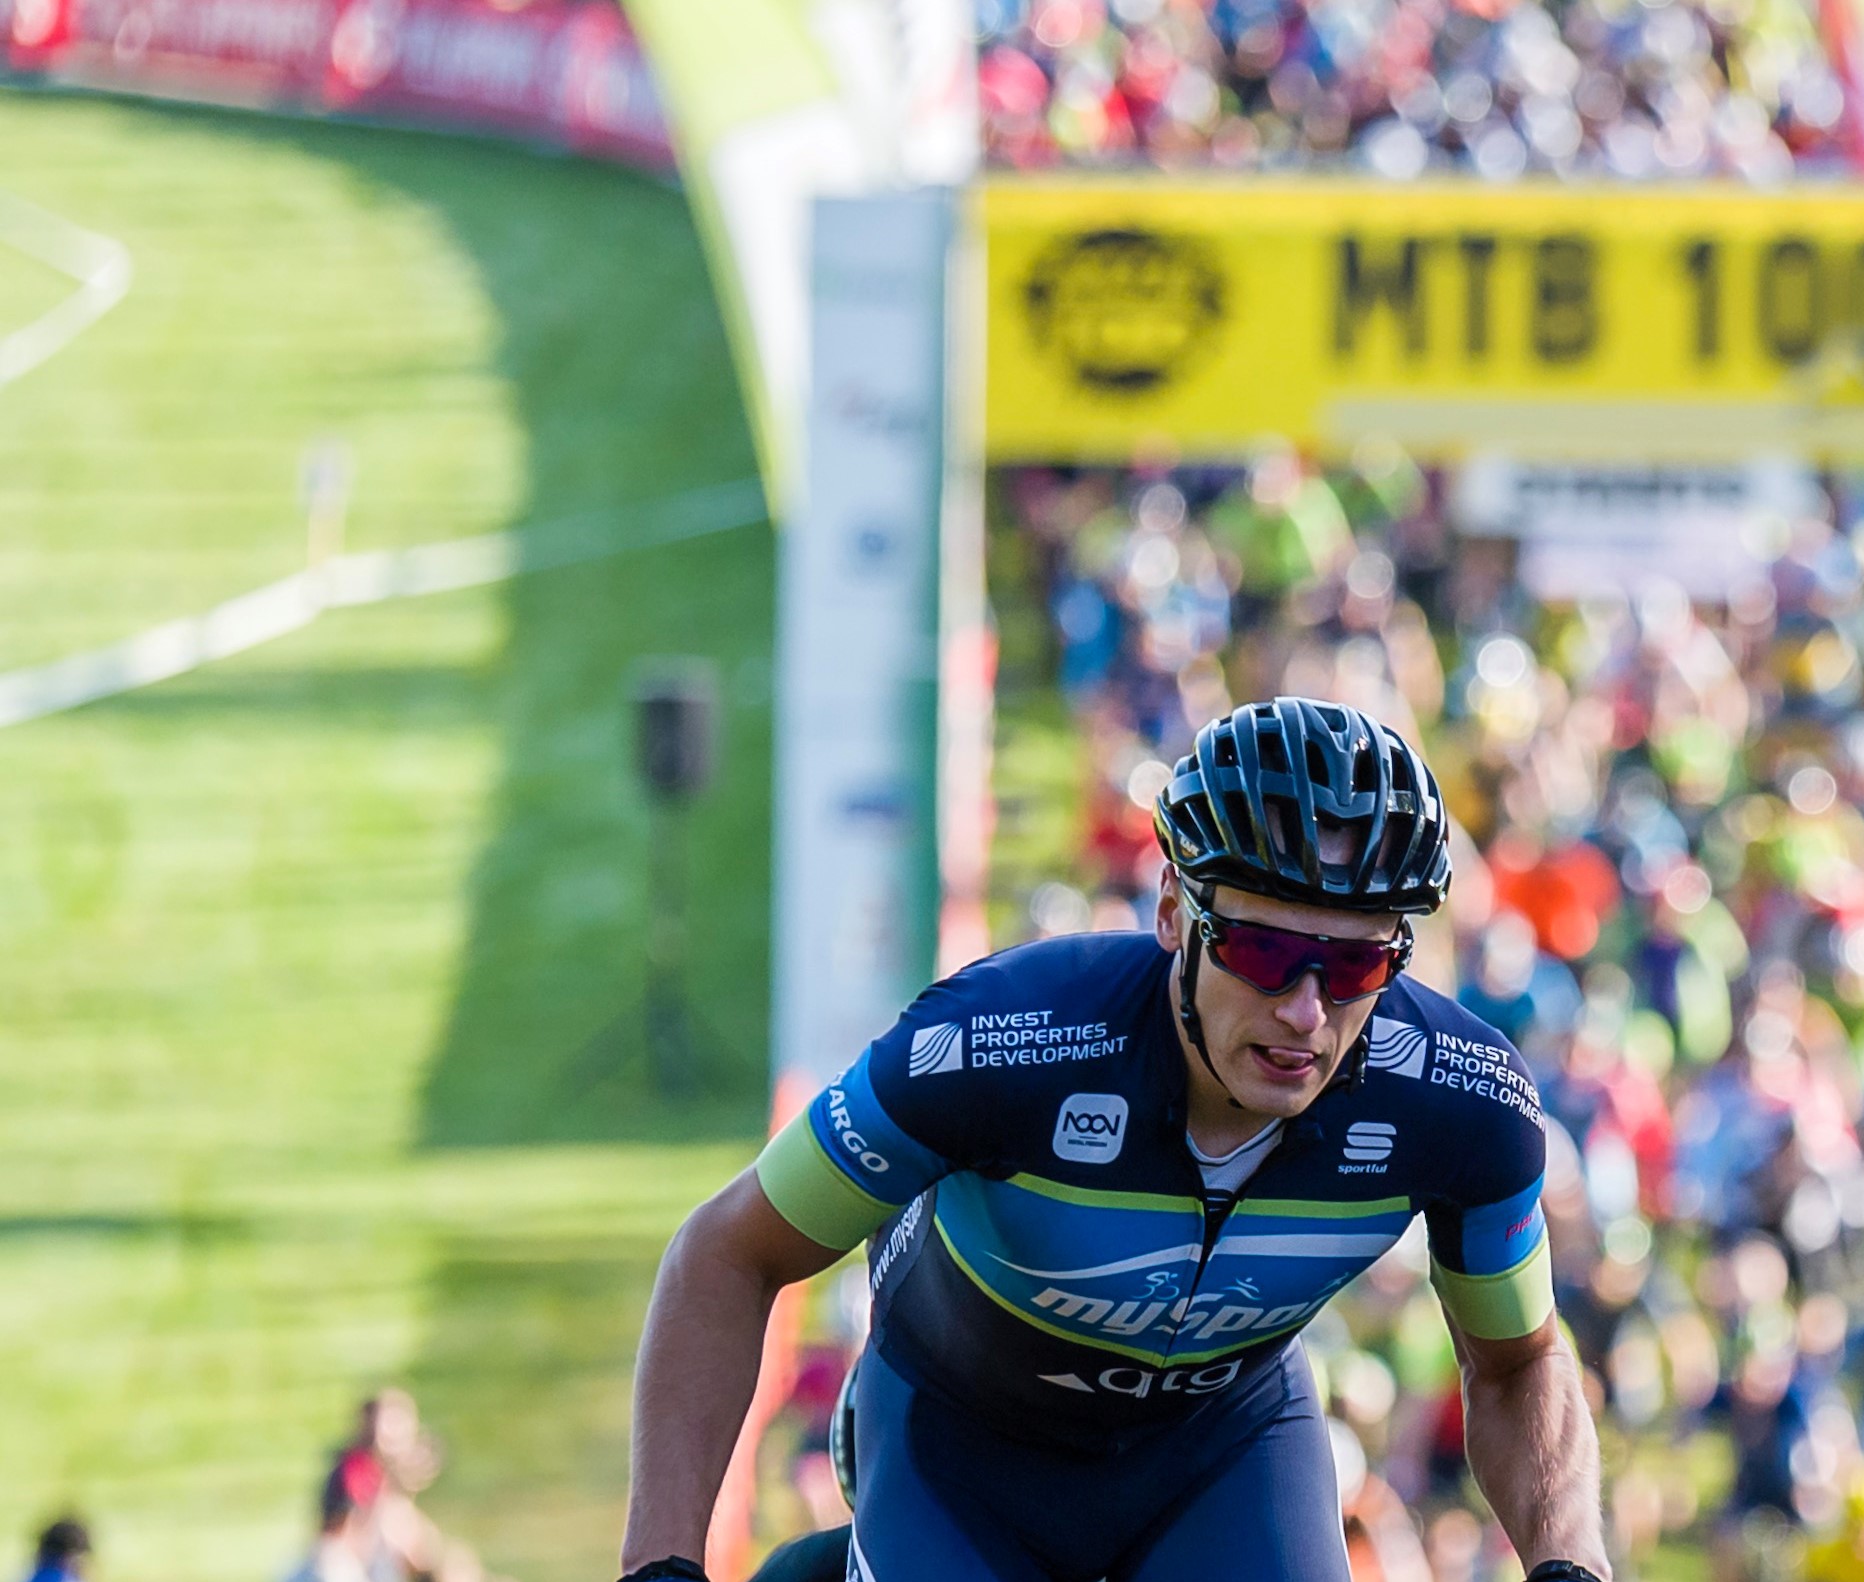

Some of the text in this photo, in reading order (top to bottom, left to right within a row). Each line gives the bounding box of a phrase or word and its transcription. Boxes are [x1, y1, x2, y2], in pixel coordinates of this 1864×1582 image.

[1330, 233, 1606, 368] MTB
[971, 1011, 1053, 1031] INVEST
[971, 1022, 1108, 1050] PROPERTIES
[971, 1035, 1129, 1069] DEVELOPMENT
[1435, 1031, 1511, 1066] INVEST
[1434, 1049, 1541, 1107] PROPERTIES
[827, 1071, 891, 1174] ARGO
[1337, 1163, 1389, 1175] sportful
